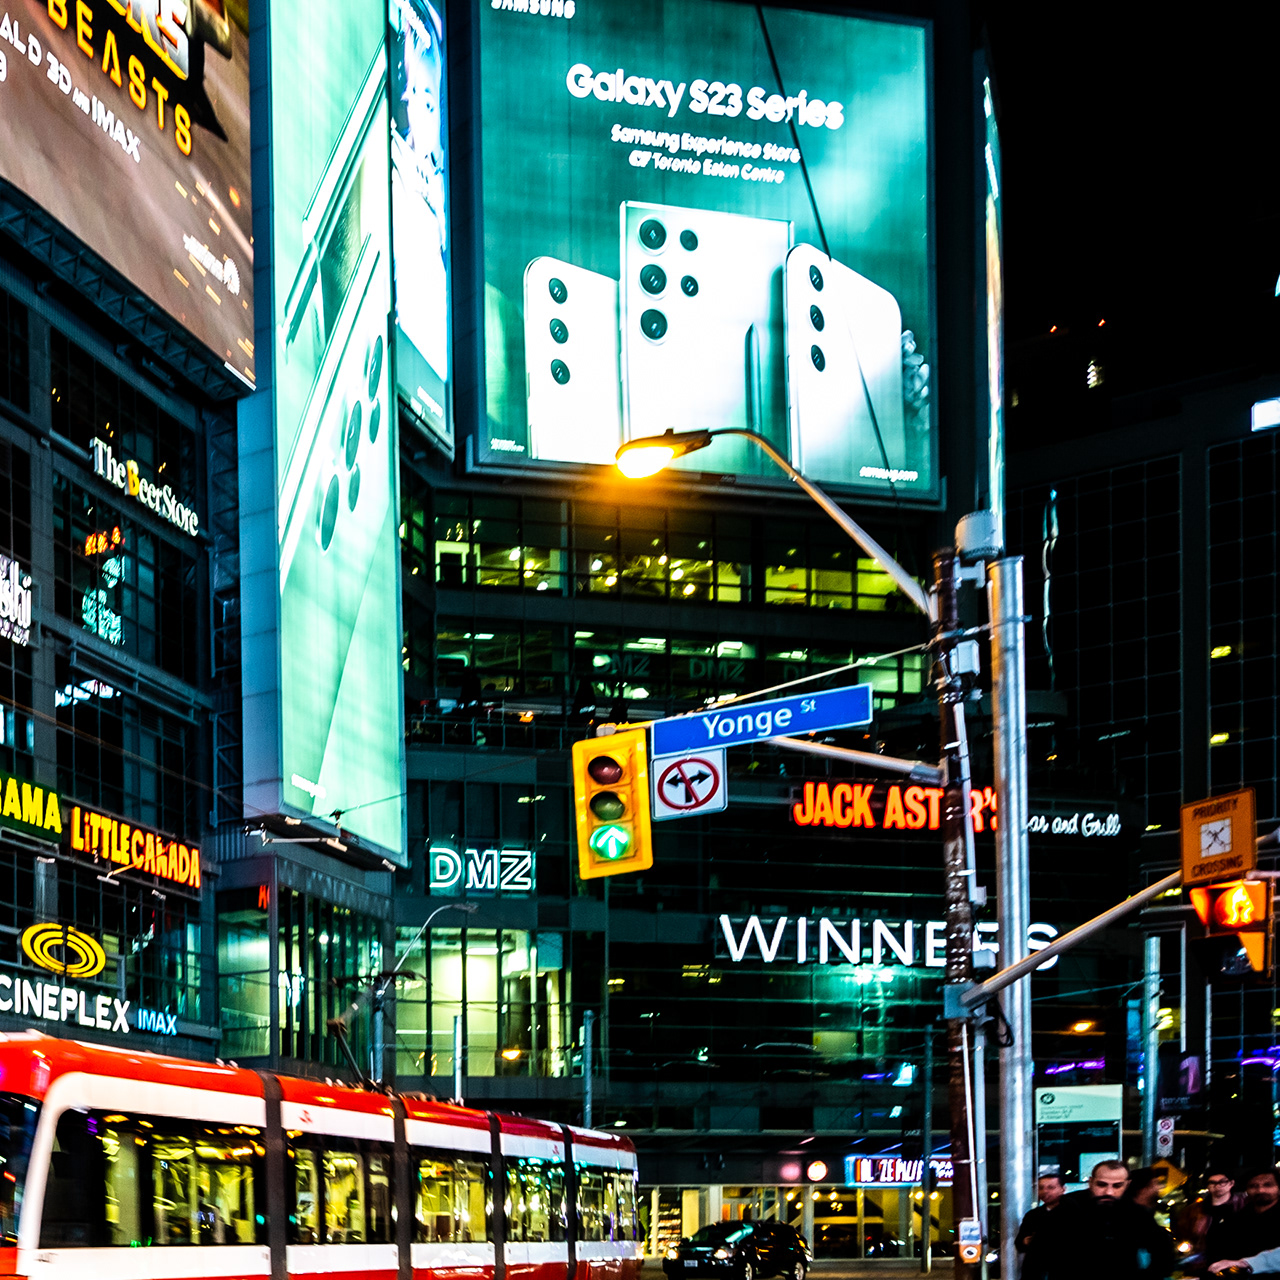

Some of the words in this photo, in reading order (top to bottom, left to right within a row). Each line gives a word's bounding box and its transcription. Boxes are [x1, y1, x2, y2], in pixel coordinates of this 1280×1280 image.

[48, 0, 191, 156] BEASTS
[566, 64, 686, 117] Galaxy
[689, 80, 742, 117] S23
[746, 87, 844, 130] Series
[46, 51, 72, 95] 3D
[91, 95, 140, 163] IMAX
[611, 124, 680, 153] Samsung
[680, 133, 762, 158] Experience
[763, 143, 801, 163] Store
[652, 152, 701, 174] Toronto
[703, 159, 739, 178] Eaton
[741, 163, 785, 184] Centre
[91, 437, 127, 489] The
[162, 484, 199, 537] Store
[689, 657, 745, 682] DMZ
[703, 706, 793, 740] Yonge
[800, 698, 817, 714] St
[793, 782, 875, 829] JACK
[883, 786, 997, 832] ASTR'
[1028, 815, 1049, 834] ar
[1052, 814, 1079, 835] and
[1081, 813, 1122, 837] Grill
[1192, 798, 1239, 819] PRIORITY
[130, 829, 202, 888] CANADA
[429, 848, 534, 890] DMZ
[1191, 855, 1243, 878] CROSSING
[137, 1008, 178, 1036] IMAX
